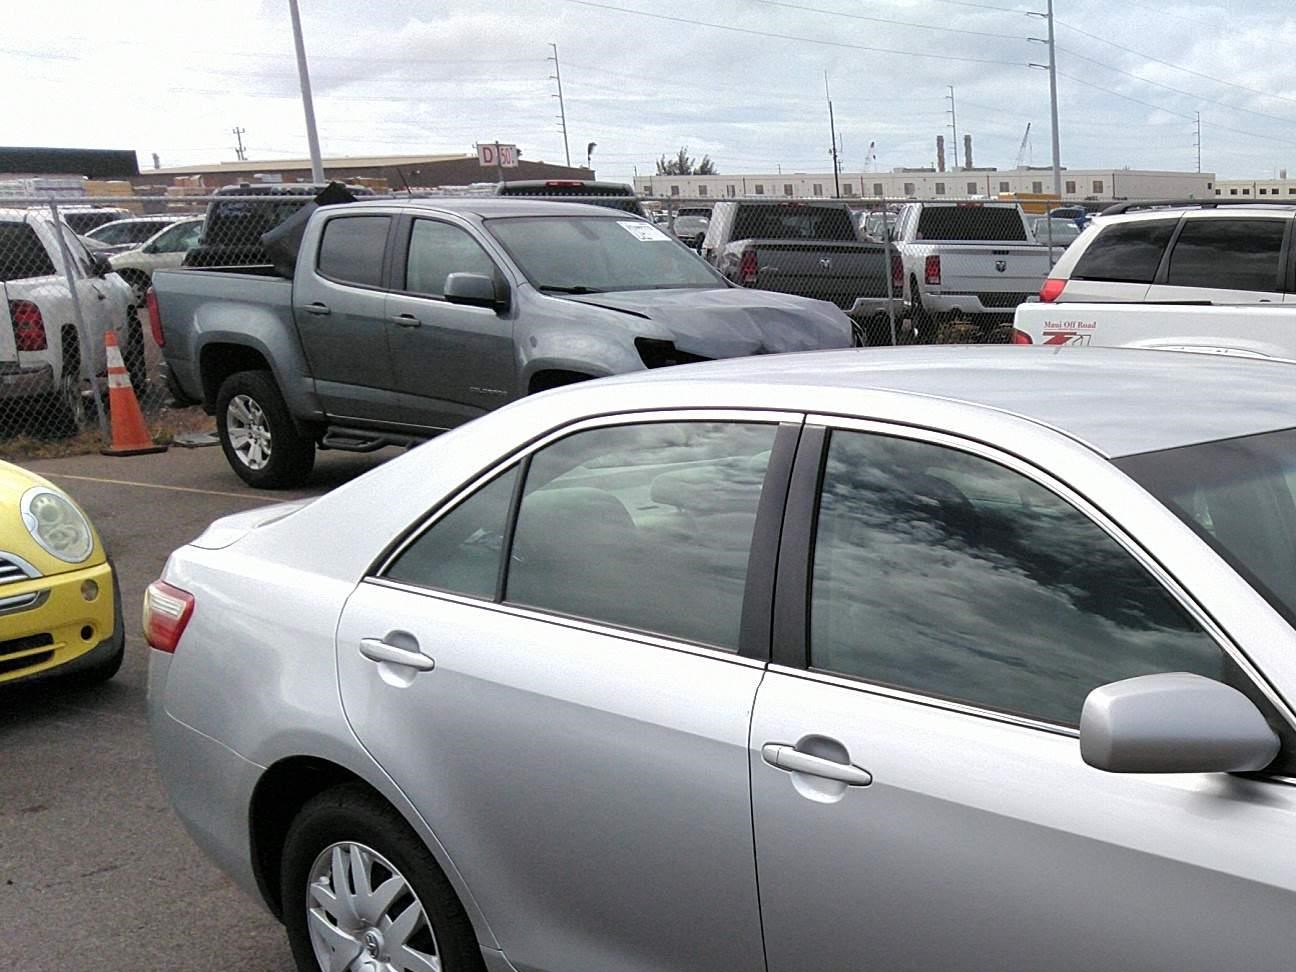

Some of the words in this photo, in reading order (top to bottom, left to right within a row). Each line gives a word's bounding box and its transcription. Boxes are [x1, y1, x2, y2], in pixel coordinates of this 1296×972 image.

[482, 147, 493, 163] D
[1063, 321, 1076, 329] Off
[1077, 321, 1097, 329] Road
